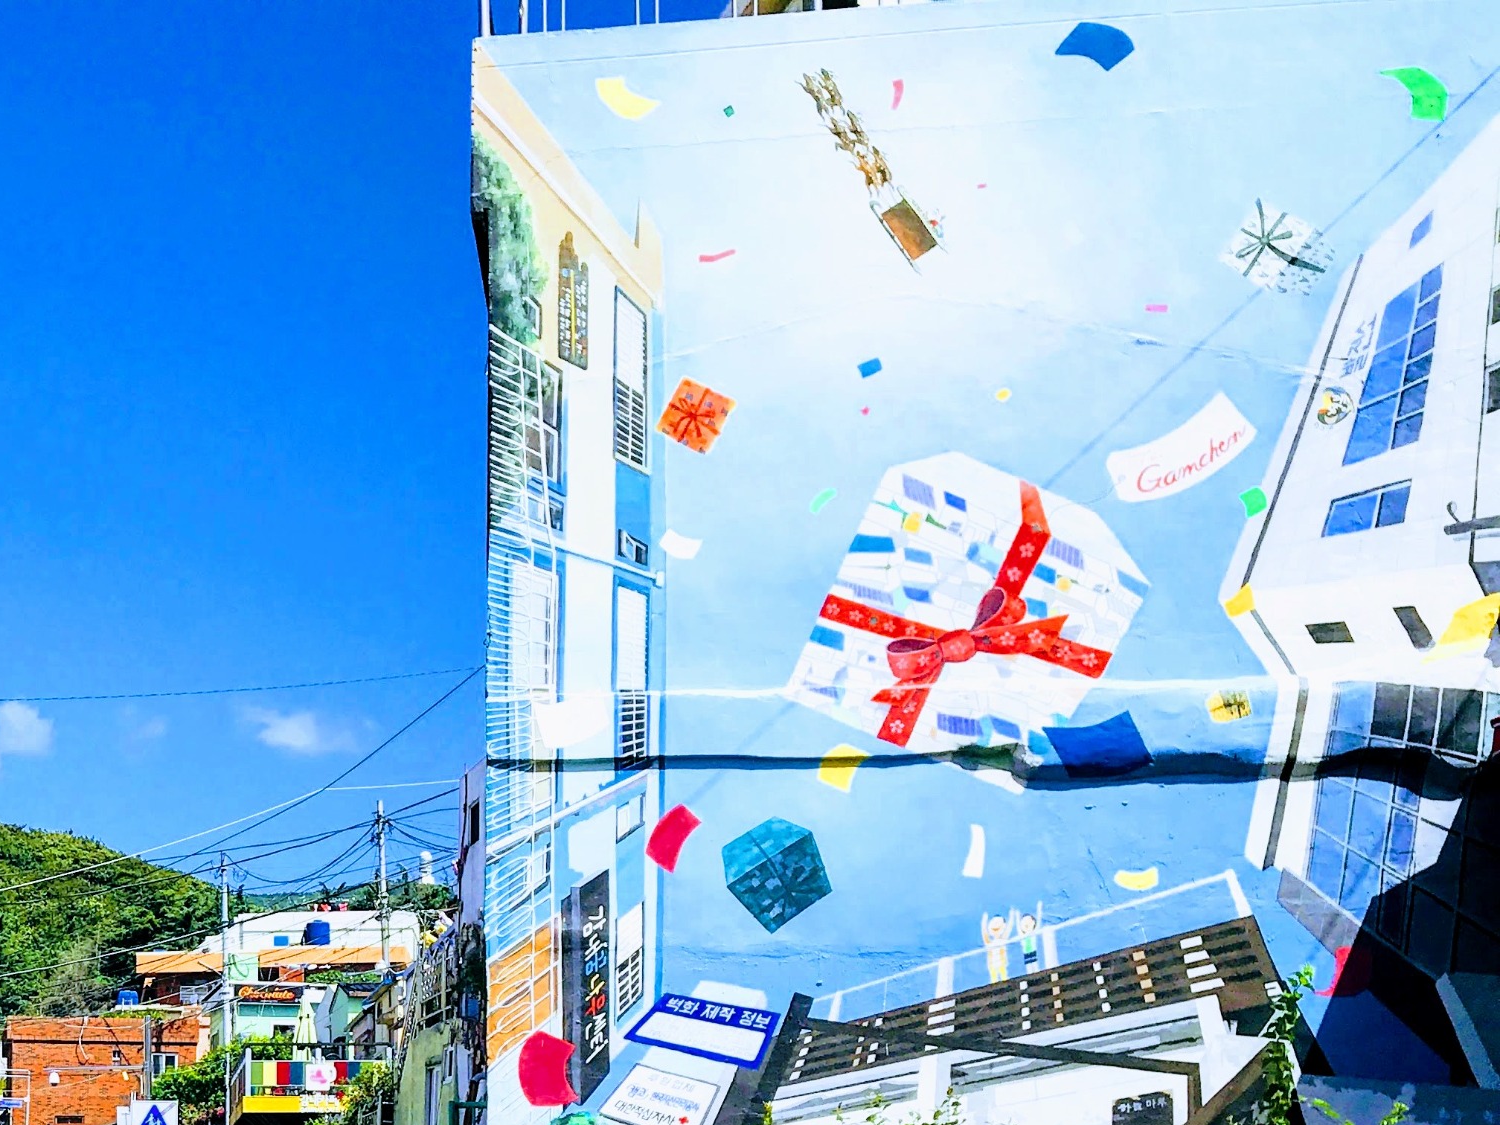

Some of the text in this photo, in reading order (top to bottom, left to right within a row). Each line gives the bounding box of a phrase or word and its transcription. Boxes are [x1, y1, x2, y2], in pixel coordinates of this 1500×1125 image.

[666, 996, 772, 1030] 벽화 제작 정보
